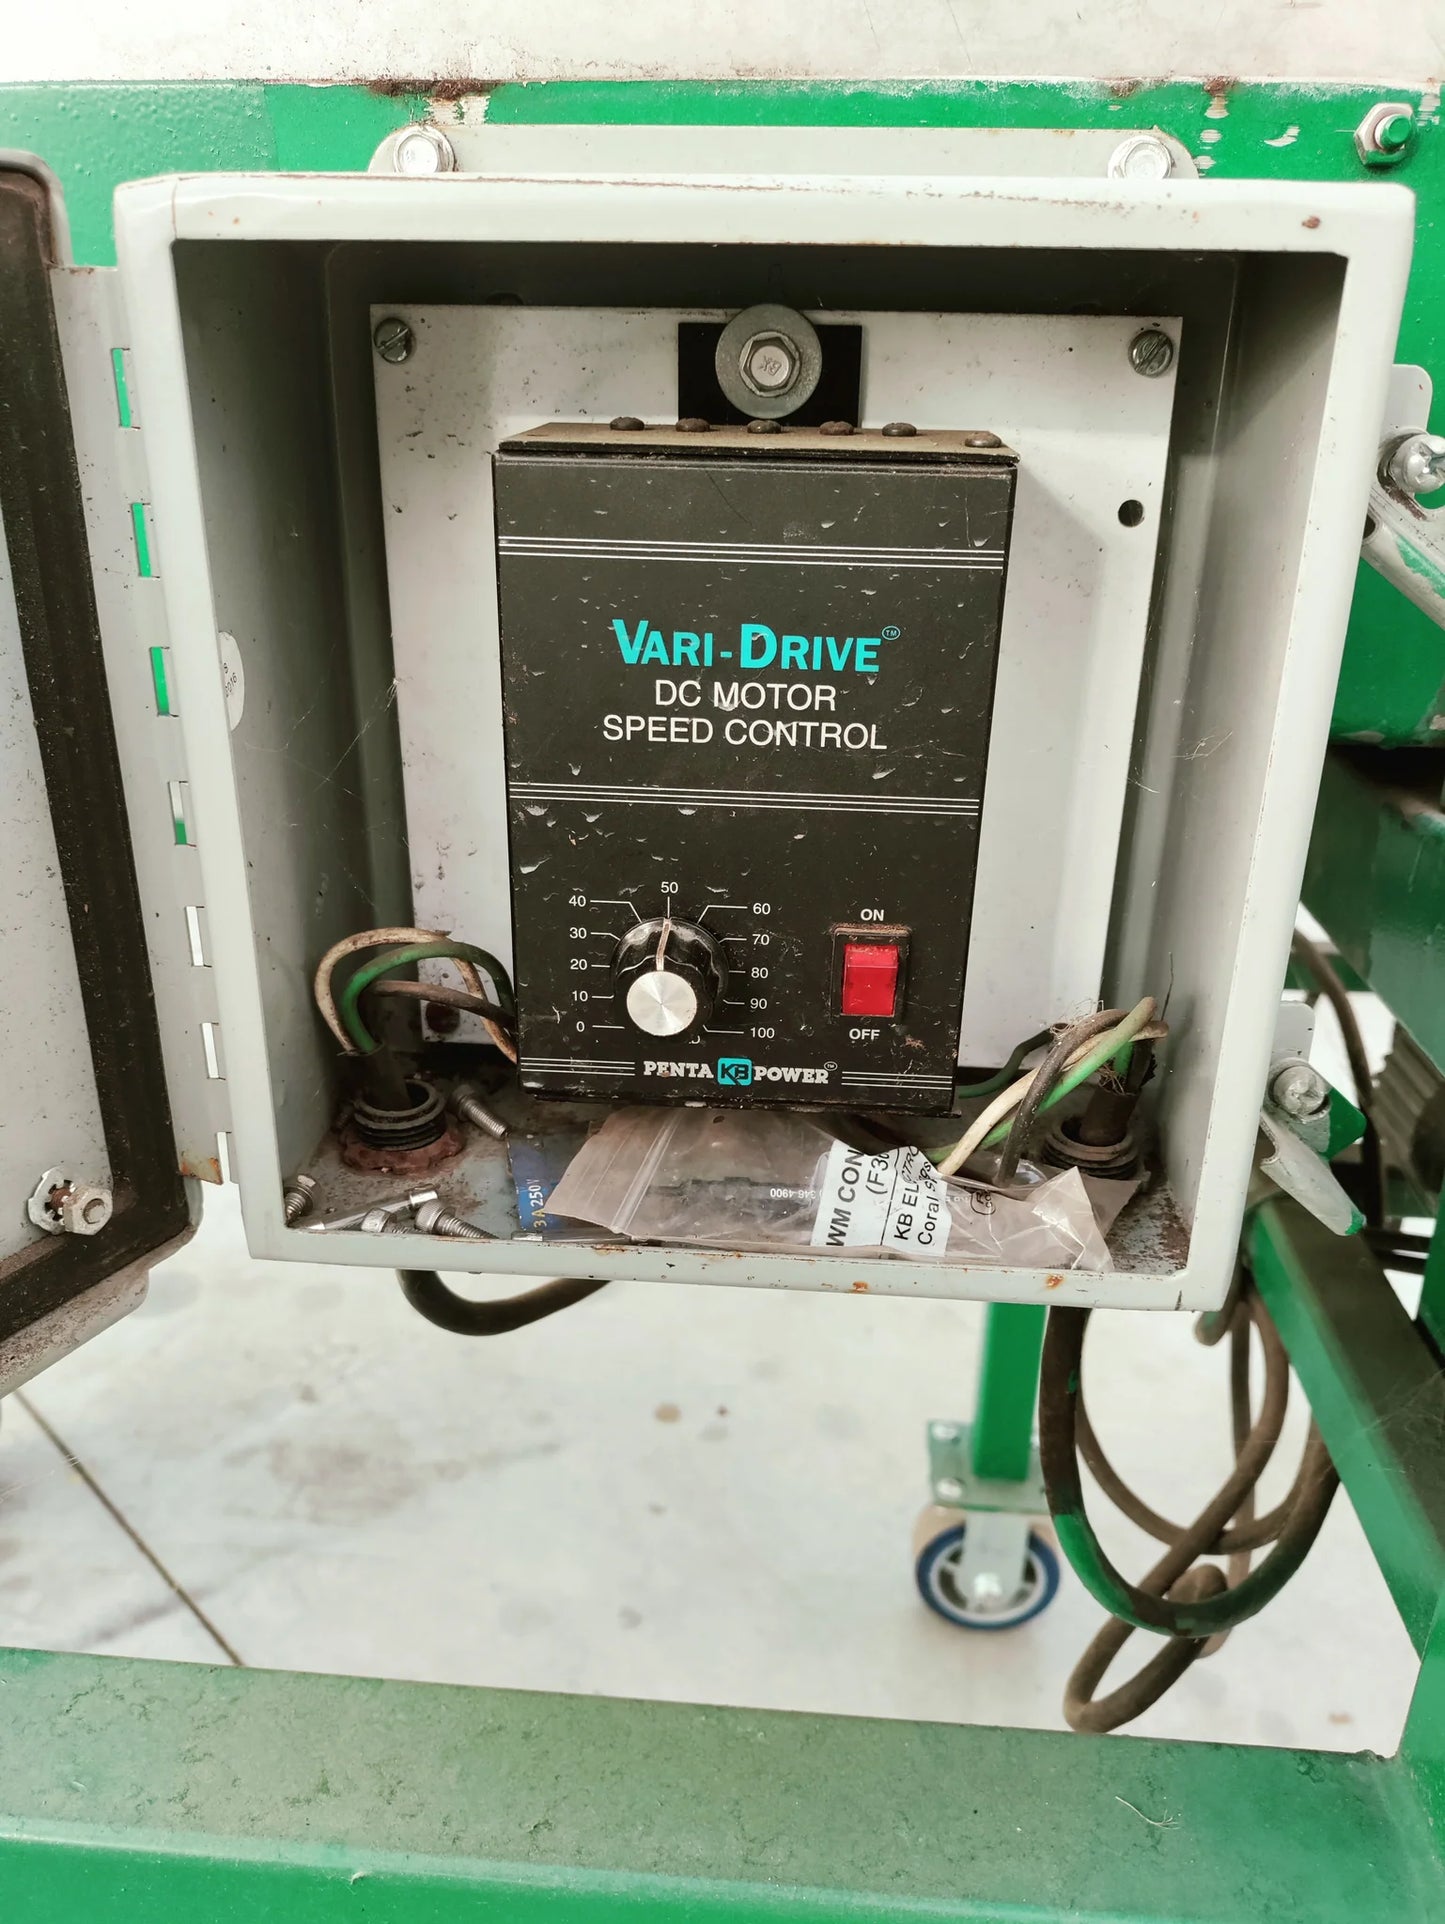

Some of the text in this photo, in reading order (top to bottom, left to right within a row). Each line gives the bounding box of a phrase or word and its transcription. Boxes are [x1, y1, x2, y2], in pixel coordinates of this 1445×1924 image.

[612, 619, 881, 673] VARI-DRIVE
[655, 679, 836, 711] DC MOTOR
[602, 715, 888, 750] SPEED CONTROL
[660, 881, 679, 894] 50
[568, 894, 587, 908] 40
[752, 902, 771, 915] 60
[860, 908, 885, 922] ON
[569, 926, 588, 940] 30
[752, 933, 770, 946] 70
[570, 958, 588, 971] 20
[751, 966, 769, 979] 80
[572, 989, 588, 1002] 10
[750, 997, 768, 1010] 90
[576, 1020, 585, 1033] 0
[750, 1026, 776, 1039] 100
[849, 1027, 881, 1042] OFF
[643, 1060, 714, 1079] PENTA
[721, 1063, 749, 1082] KB
[753, 1065, 829, 1084] POWER
[826, 1207, 852, 1246] WM
[894, 1212, 914, 1241] KB
[917, 1195, 939, 1245] Coral
